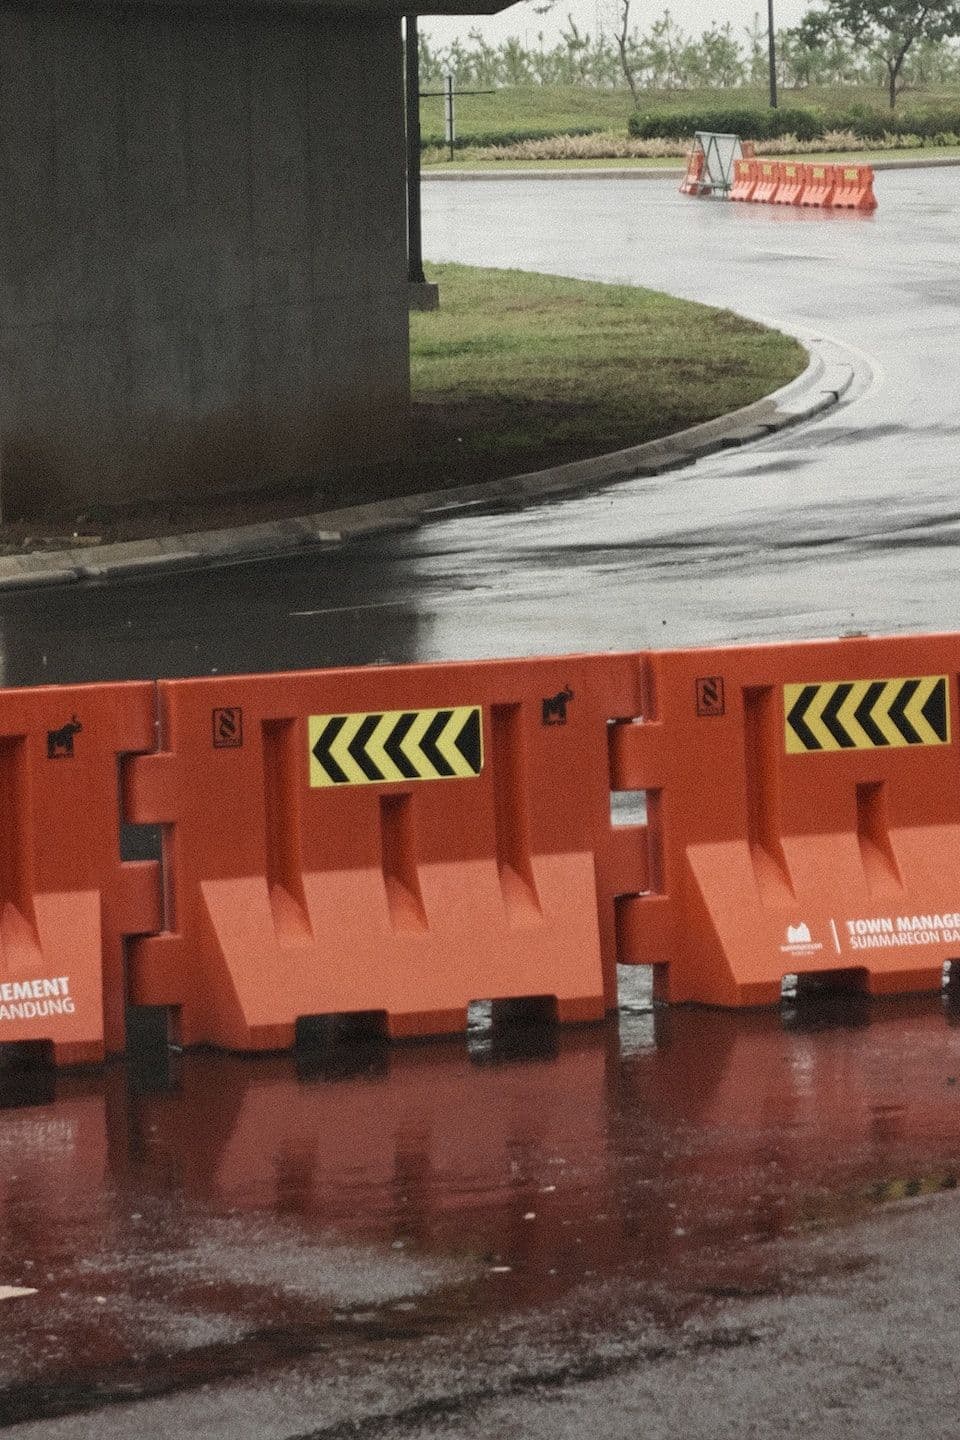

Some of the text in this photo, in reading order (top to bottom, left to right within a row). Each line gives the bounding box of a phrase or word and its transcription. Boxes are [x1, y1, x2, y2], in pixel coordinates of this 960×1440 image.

[847, 918, 893, 936] TOWN
[850, 930, 940, 949] SUMMARECON
[0, 976, 69, 1001] EMENT
